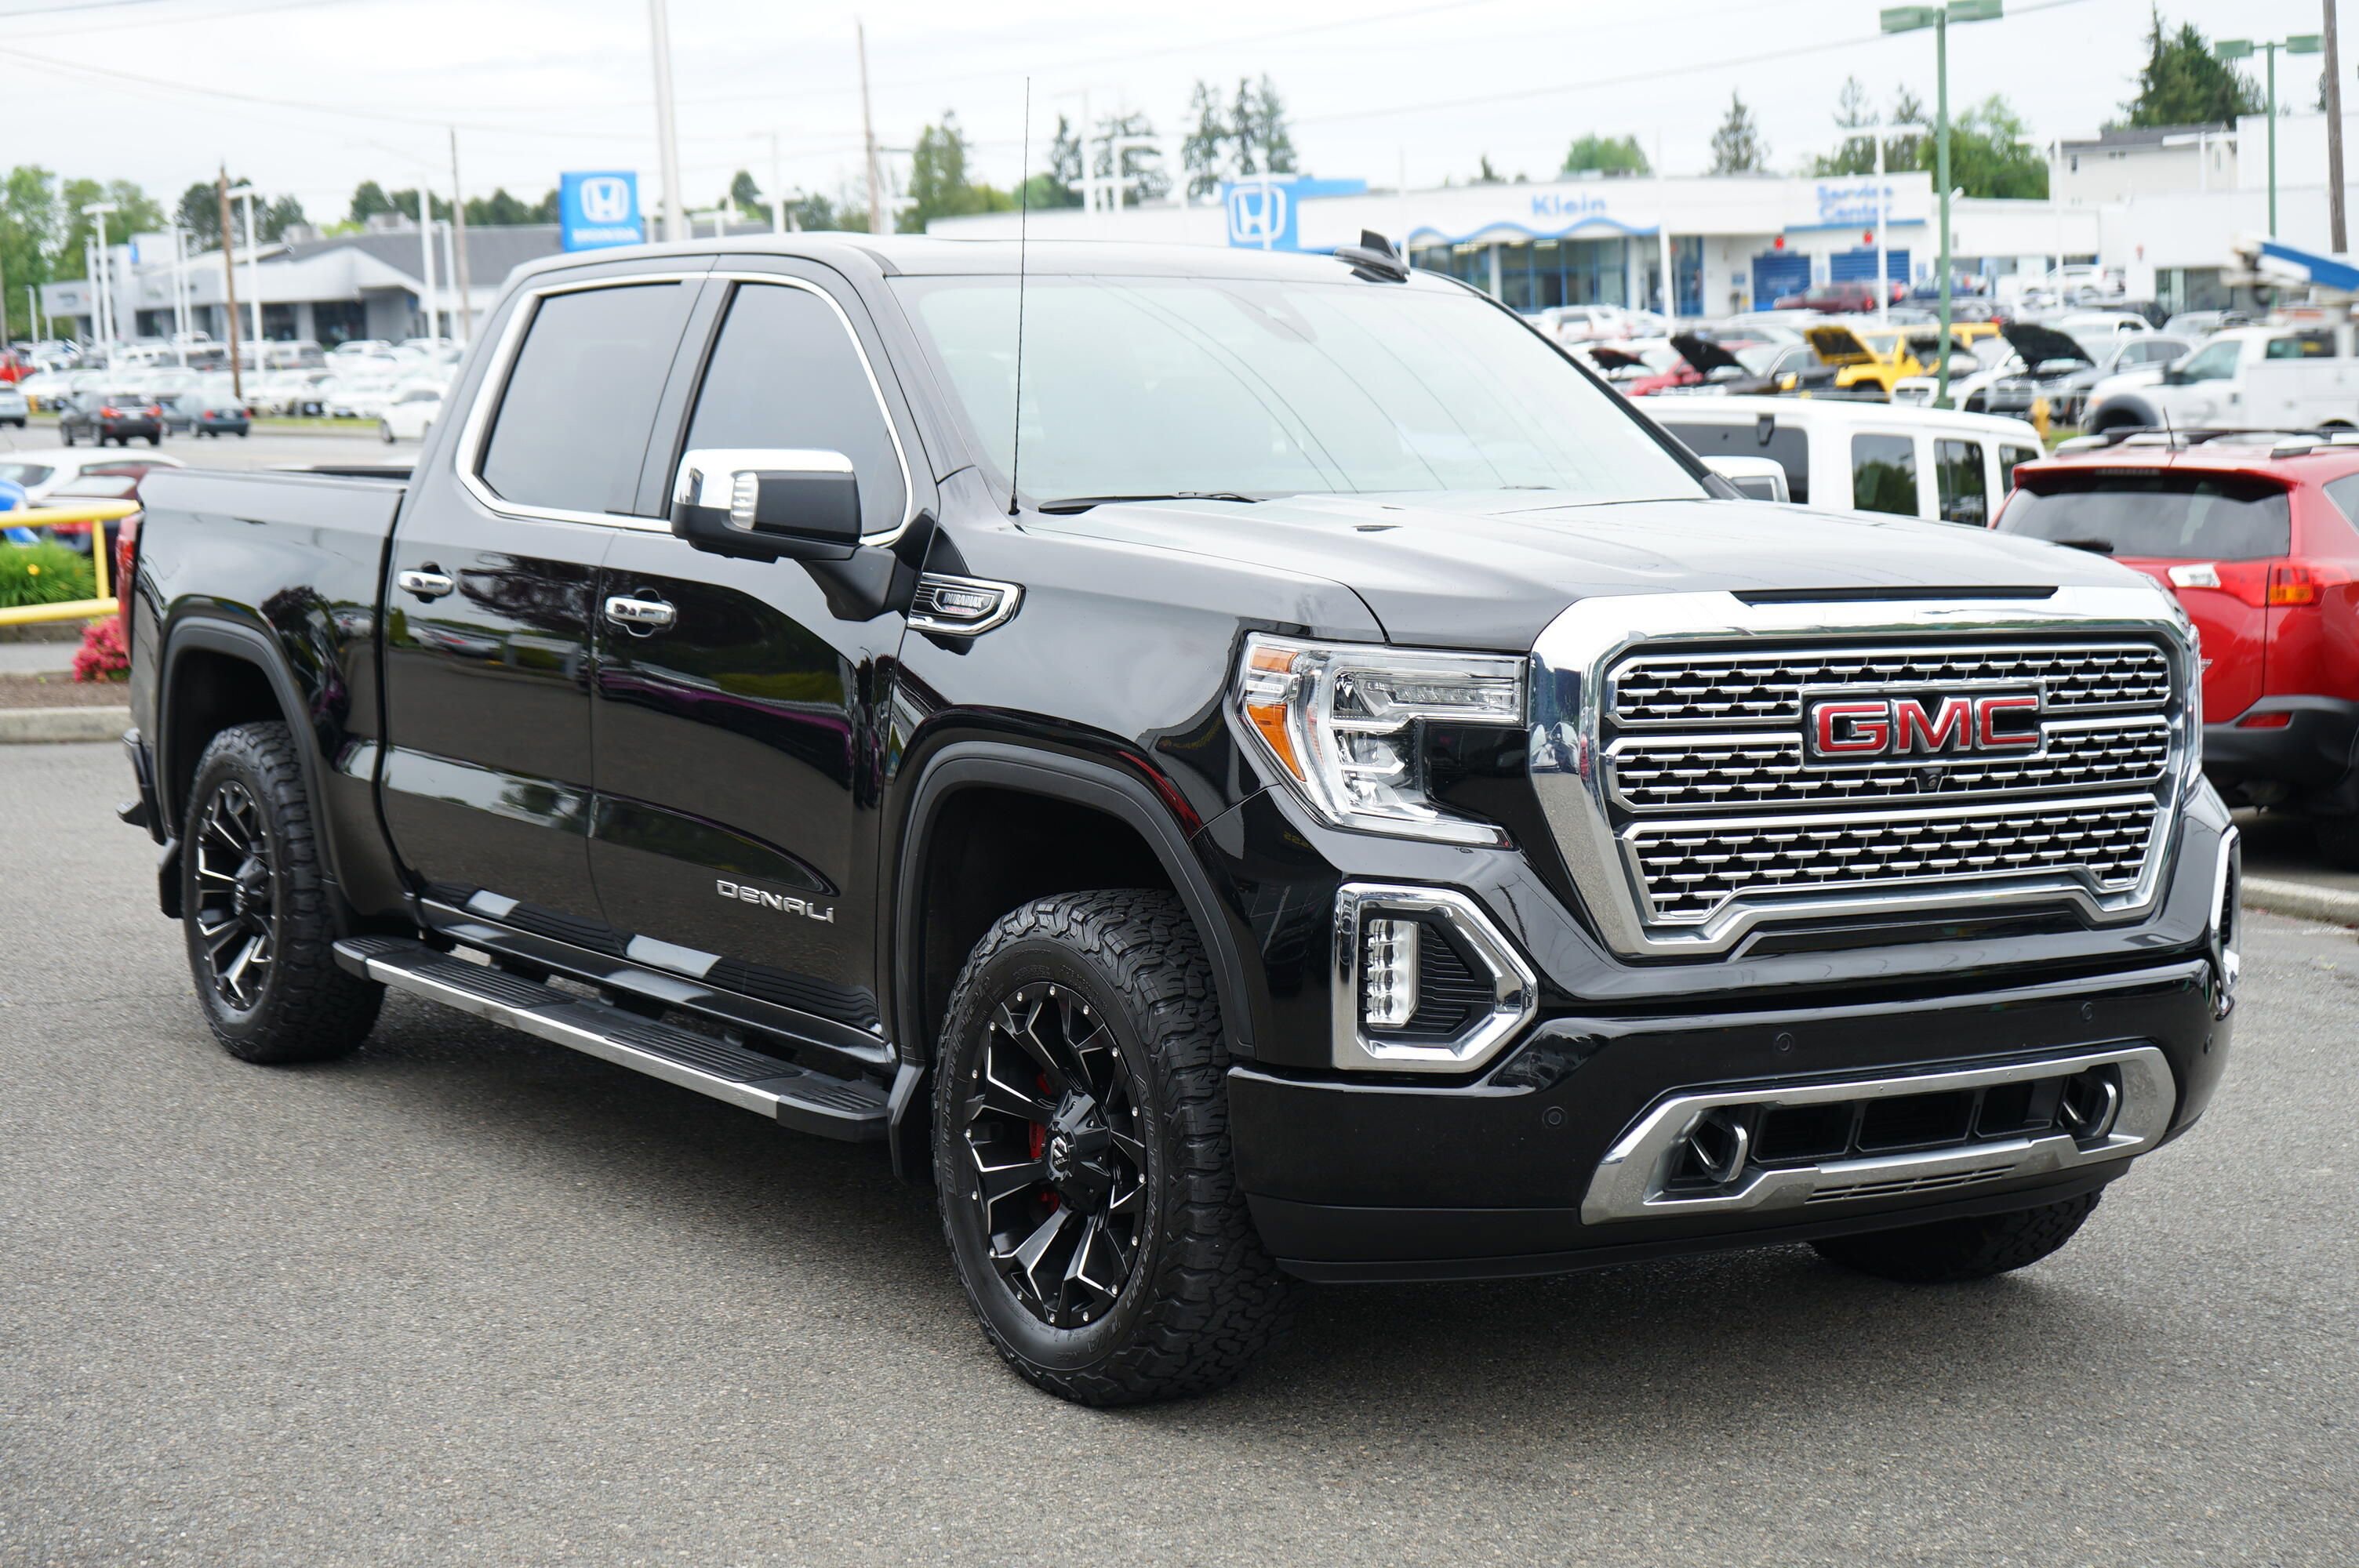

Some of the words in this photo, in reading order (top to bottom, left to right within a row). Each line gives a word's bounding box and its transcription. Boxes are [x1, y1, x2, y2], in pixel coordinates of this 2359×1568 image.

[1532, 194, 1606, 216] Klein
[1812, 695, 2039, 757] GMC
[716, 879, 834, 924] DENALI
